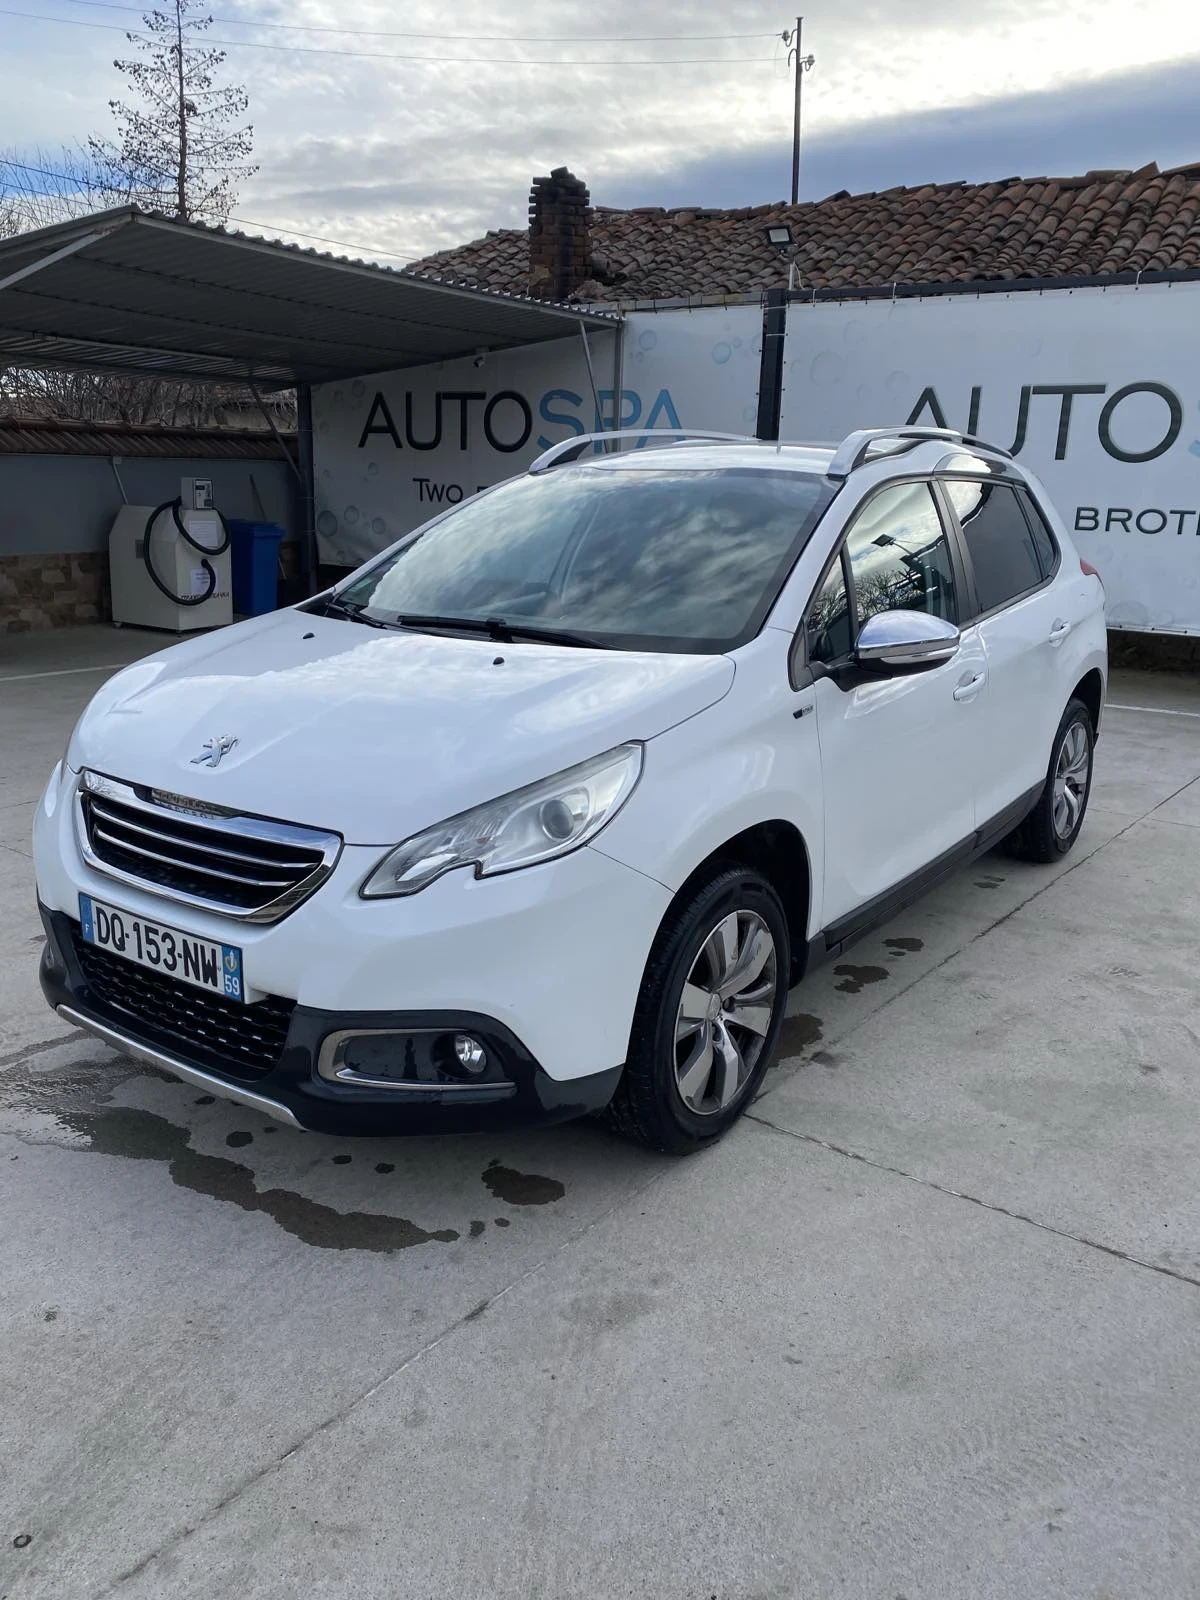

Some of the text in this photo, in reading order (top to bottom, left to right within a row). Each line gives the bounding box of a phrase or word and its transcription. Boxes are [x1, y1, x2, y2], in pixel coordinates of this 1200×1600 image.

[905, 381, 1200, 463] AUTO
[1074, 506, 1200, 536] BROT
[84, 905, 241, 996] F DQ-153-NW 59
